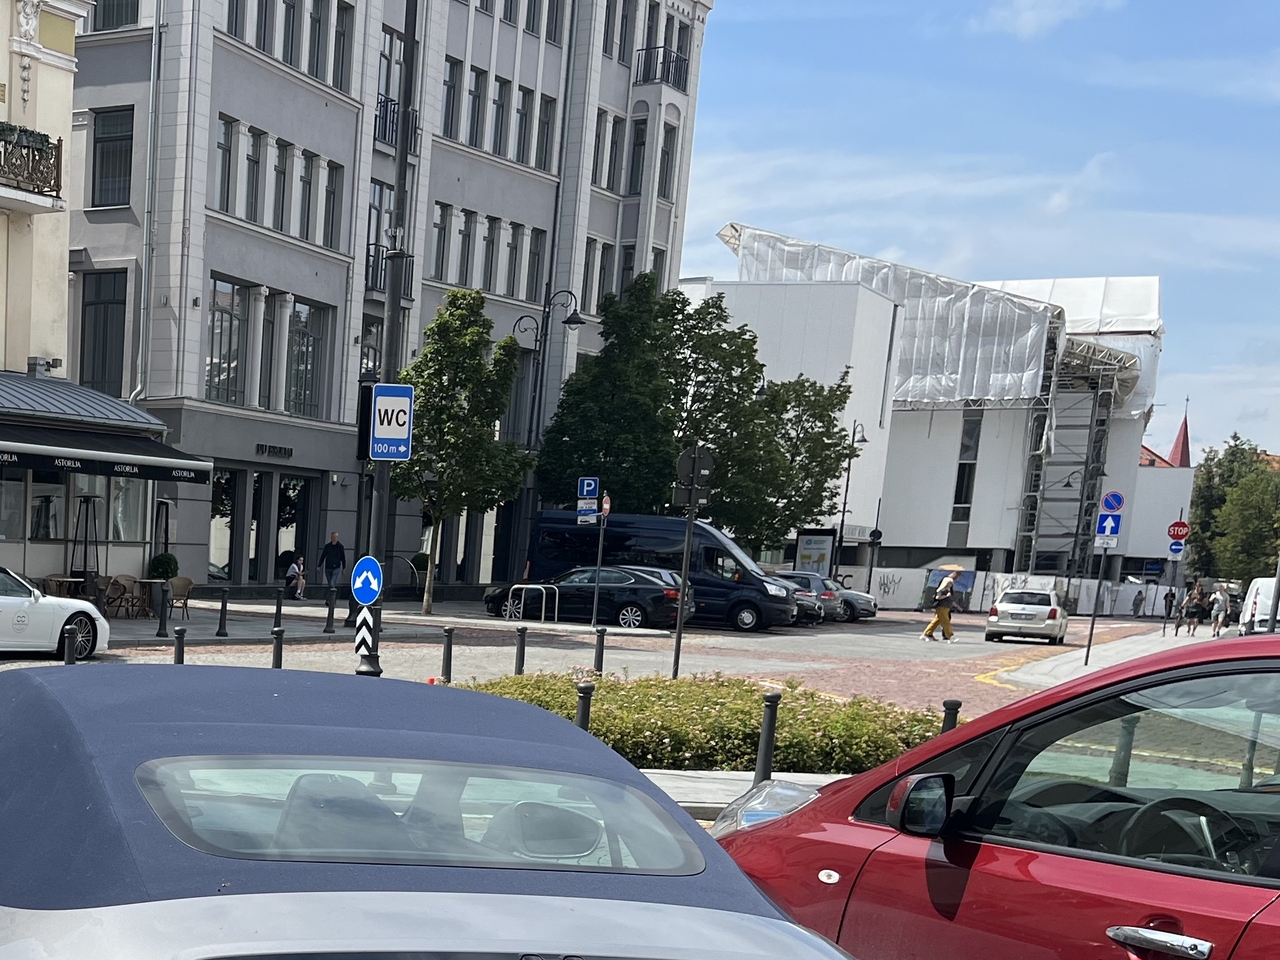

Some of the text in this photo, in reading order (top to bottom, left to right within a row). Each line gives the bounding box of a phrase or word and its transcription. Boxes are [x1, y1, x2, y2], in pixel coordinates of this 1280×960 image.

[378, 408, 407, 427] WC
[374, 443, 388, 453] 100
[54, 458, 82, 469] ASTORIJA
[113, 464, 139, 474] ASTORIJA
[171, 469, 195, 478] ASTORIJA
[584, 480, 595, 495] P
[1169, 527, 1188, 535] STOP
